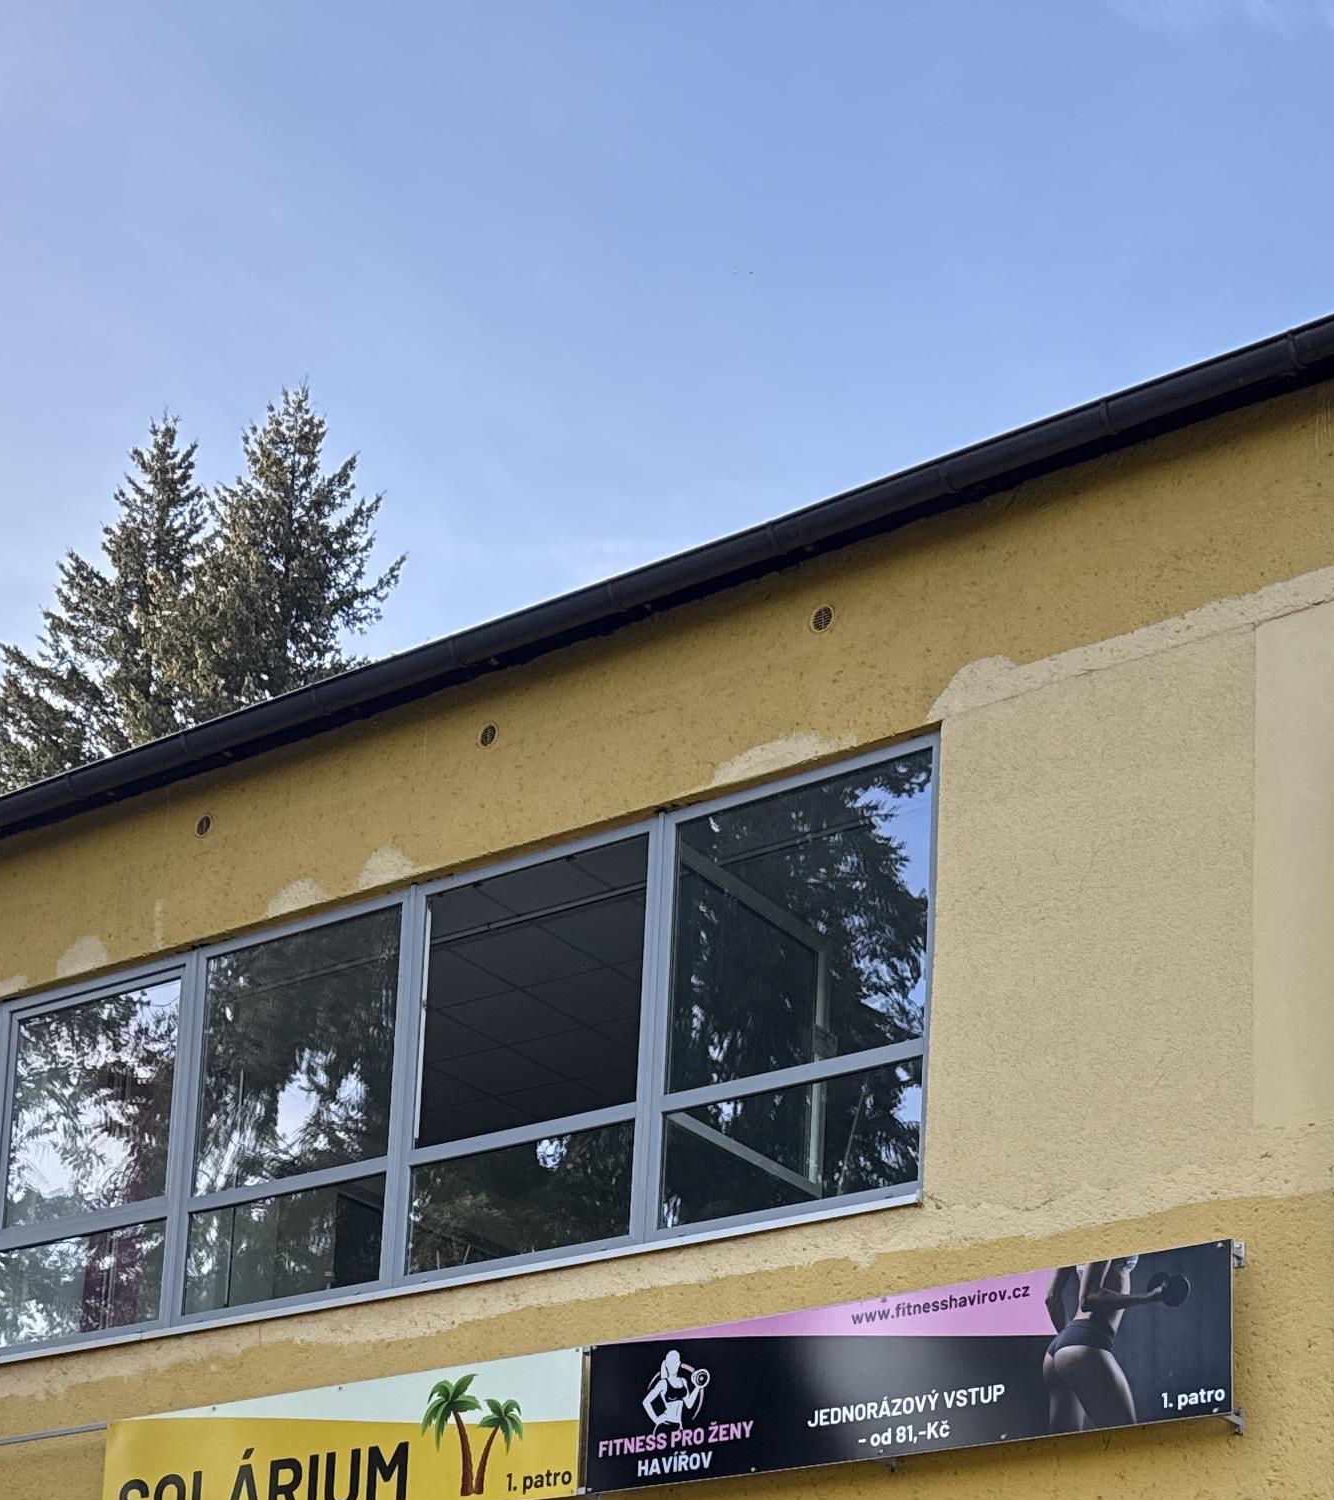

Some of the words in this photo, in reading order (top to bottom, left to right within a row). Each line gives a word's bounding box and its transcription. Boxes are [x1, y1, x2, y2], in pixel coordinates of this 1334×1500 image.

[850, 1282, 1031, 1326] www.fitnesshavirov.cz
[807, 1388, 940, 1428] JEDNORÁZOVÝ
[943, 1383, 1006, 1410] VSTUP
[1161, 1391, 1173, 1410] 1.
[1177, 1387, 1225, 1412] patro
[598, 1431, 668, 1458] FITNESS
[670, 1426, 705, 1450] PRO
[707, 1419, 755, 1444] ŽENY
[870, 1425, 892, 1447] od
[637, 1449, 713, 1477] HAVÍŘOV
[505, 1471, 518, 1493] 1.
[521, 1469, 573, 1496] patro
